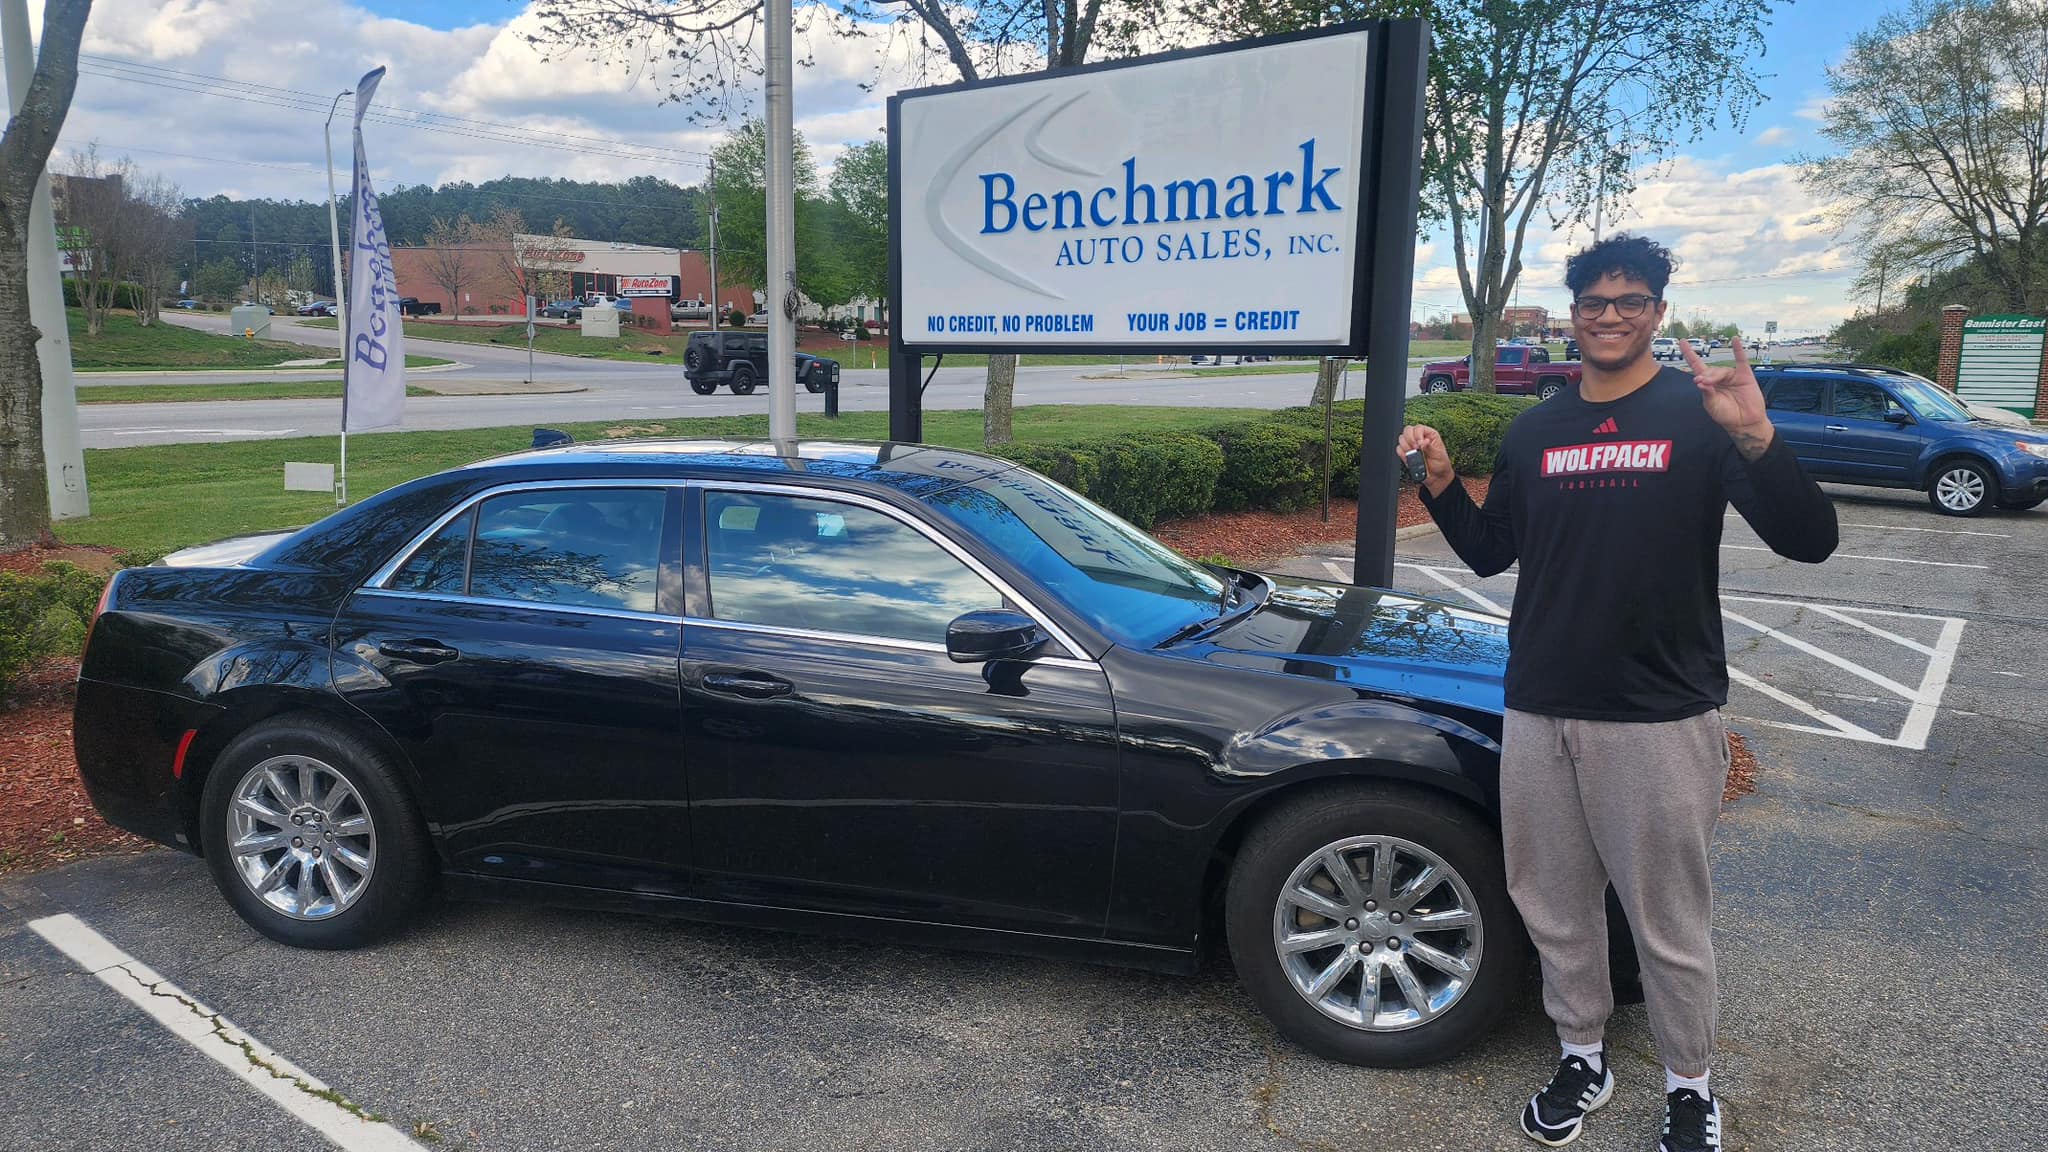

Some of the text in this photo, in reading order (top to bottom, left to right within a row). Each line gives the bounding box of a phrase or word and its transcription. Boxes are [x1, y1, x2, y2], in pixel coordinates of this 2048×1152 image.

[978, 137, 1343, 235] Benchmark
[1056, 228, 1340, 267] AUTO SALES, INC.
[631, 277, 669, 289] AutoZone
[927, 313, 1095, 335] NO CREDIT, NO PROBLEM
[1127, 312, 1170, 333] YOUR
[1174, 311, 1208, 333] JOB
[1234, 309, 1302, 333] CREDIT
[1964, 319, 2047, 328] Bannister East
[1546, 443, 1667, 474] WOLFPACK
[1559, 479, 1639, 491] FOOTBALL
